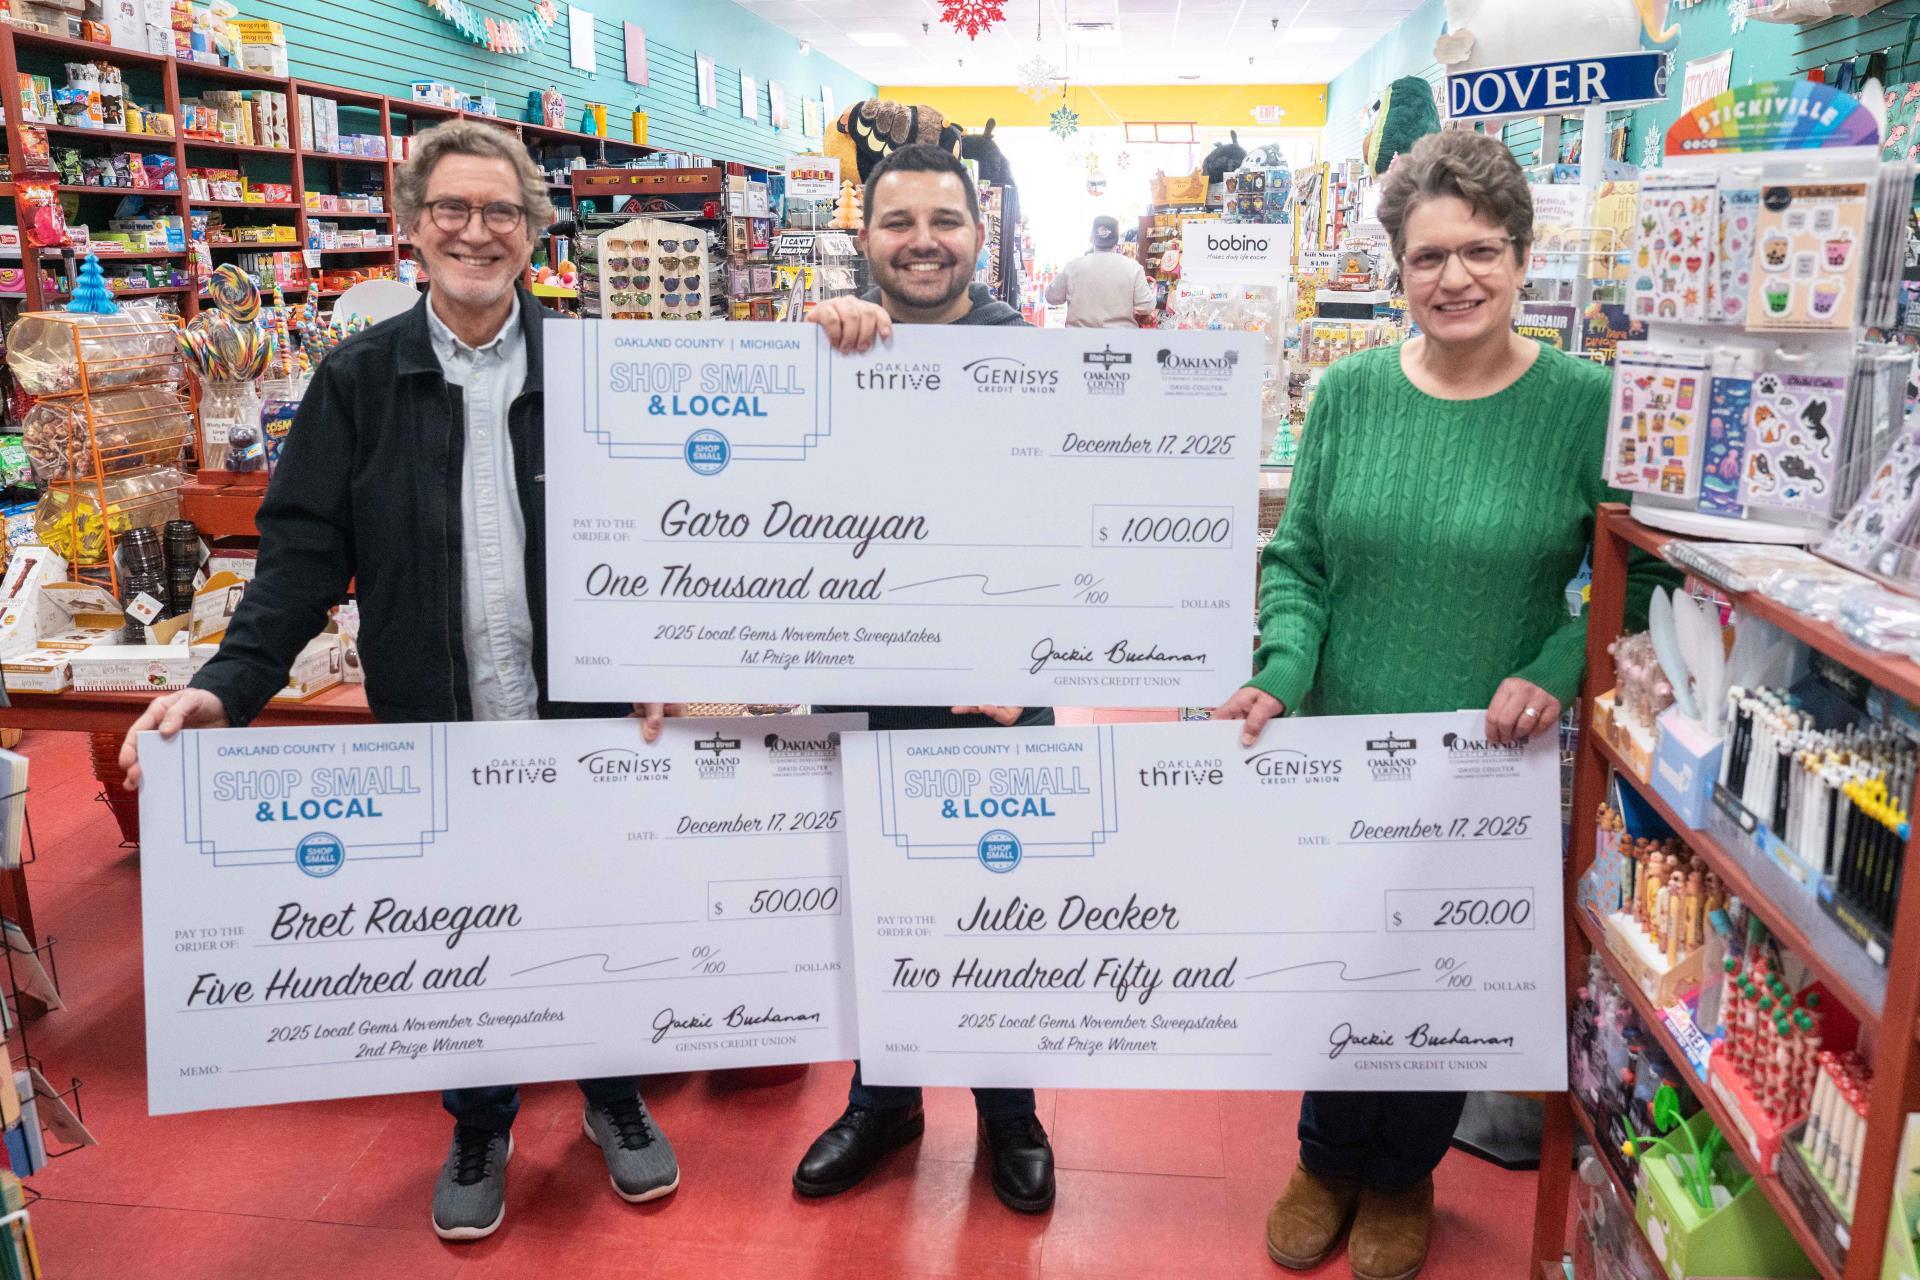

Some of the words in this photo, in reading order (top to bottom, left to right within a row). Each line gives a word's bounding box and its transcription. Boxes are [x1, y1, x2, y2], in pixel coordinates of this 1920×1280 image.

[1451, 61, 1610, 116] DOVER
[1259, 105, 1276, 119] EXIT
[1698, 97, 1839, 134] STICKIVILLE
[1207, 234, 1268, 251] bobino
[1517, 327, 1560, 338] TATTOOS
[614, 337, 672, 349] OAKLAND
[674, 338, 724, 350] COUNTY
[740, 338, 800, 351] MICHIGAN
[610, 362, 692, 393] SHOP
[700, 364, 805, 395] SMALL
[855, 368, 940, 390] thrive
[874, 363, 941, 373] OAKLAND
[977, 385, 1017, 394] CREDIT
[1022, 386, 1055, 394] UNION
[648, 394, 666, 416] &
[672, 395, 768, 417] LOCAL
[694, 444, 720, 453] SHOP
[1062, 432, 1151, 455] December
[1180, 435, 1236, 455] 2025
[692, 452, 722, 461] SMALL
[572, 518, 594, 529] PAY
[595, 518, 611, 529] TO
[613, 519, 637, 529] THE
[660, 499, 750, 538] Garo
[763, 501, 929, 560] Danayan
[1099, 526, 1108, 542] $
[572, 531, 612, 542] ORDER
[585, 563, 648, 598] One
[660, 563, 815, 599] Thousand
[818, 567, 886, 600] and
[1181, 599, 1231, 609] DOLLARS
[653, 625, 696, 641] 2025
[698, 625, 736, 642] Local
[739, 626, 779, 643] Gems
[783, 627, 850, 643] November
[853, 628, 942, 647] Sweepstakes
[762, 650, 800, 670] Prize
[803, 651, 855, 666] Winner
[1030, 638, 1094, 674] Jackie
[1104, 640, 1207, 664] Buchanan
[1054, 676, 1099, 686] GENISYS
[1100, 676, 1139, 686] CREDIT
[1142, 677, 1181, 687] UNION
[217, 744, 280, 758] OAKLAND
[283, 742, 336, 755] COUNTY
[352, 740, 415, 753] MICHIGAN
[906, 746, 960, 757] OAKLAND
[963, 745, 1011, 756] COUNTY
[1025, 742, 1083, 754] MICHIGAN
[490, 757, 556, 769] OAKLAND
[1157, 758, 1223, 769] OAKLAND
[213, 768, 302, 801] SHOP
[311, 765, 421, 797] SMALL
[471, 763, 557, 787] thrive
[593, 774, 632, 783] CREDIT
[636, 773, 669, 781] UNION
[904, 769, 981, 798] SHOP
[988, 766, 1090, 796] SMALL
[1139, 764, 1223, 786] thrive
[1260, 776, 1301, 785] CREDIT
[1305, 775, 1340, 783] UNION
[255, 801, 275, 822] &
[281, 798, 382, 821] LOCAL
[941, 799, 959, 818] &
[964, 798, 1056, 817] LOCAL
[676, 813, 763, 836] December
[789, 810, 841, 831] 2025
[1349, 817, 1443, 840] December
[1474, 815, 1530, 836] 2025
[749, 887, 838, 914] 500.00
[270, 902, 356, 942] Bret
[364, 898, 522, 949] Rasegan
[957, 893, 1047, 932] Julie
[1056, 893, 1180, 930] Decker
[1392, 912, 1402, 927] $
[1433, 900, 1531, 926] 250.00
[187, 972, 255, 1007] Five
[264, 961, 416, 1001] Hundred
[423, 955, 490, 990] and
[892, 958, 941, 989] Two
[952, 956, 1086, 989] Hundred
[1093, 958, 1162, 1004] Fifty
[1171, 958, 1236, 989] and
[267, 1024, 311, 1044] 2025
[312, 1021, 355, 1040] Local
[357, 1018, 399, 1037] Gems
[401, 1014, 474, 1034] November
[477, 1007, 565, 1032] Sweepstakes
[651, 1007, 716, 1044] Jackie
[723, 1003, 821, 1028] Buchanan
[958, 1014, 997, 1029] 2025
[998, 1015, 1035, 1030] Local
[1038, 1014, 1076, 1030] Gems
[1080, 1014, 1147, 1030] November
[1150, 1014, 1238, 1034] Sweepstakes
[355, 1040, 386, 1058] 2nd
[388, 1037, 427, 1059] Prize
[431, 1035, 484, 1054] Winner
[1037, 1036, 1063, 1052] 3rd
[1067, 1036, 1105, 1057] Prize
[1107, 1037, 1158, 1052] Winner
[1329, 1022, 1394, 1059] Jackie
[1405, 1024, 1514, 1051] Buchanan
[1354, 1061, 1401, 1071] GENISYS
[1403, 1061, 1444, 1071] CREDIT
[1448, 1060, 1488, 1070] UNION
